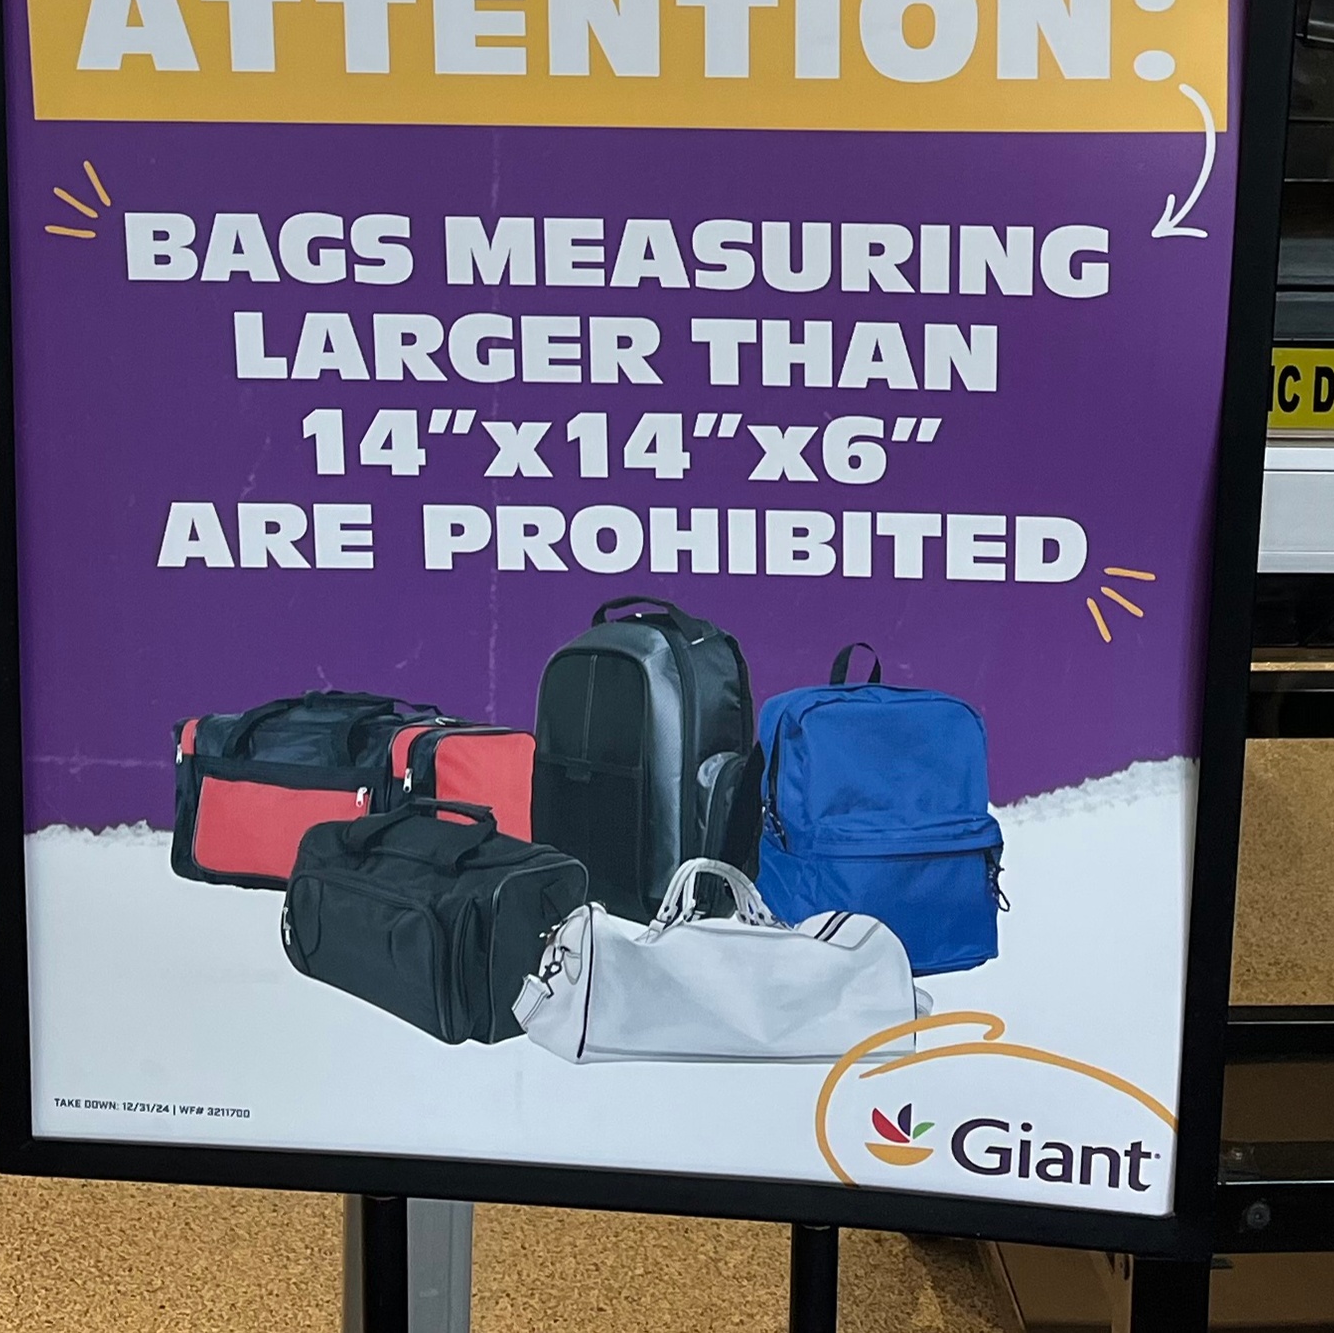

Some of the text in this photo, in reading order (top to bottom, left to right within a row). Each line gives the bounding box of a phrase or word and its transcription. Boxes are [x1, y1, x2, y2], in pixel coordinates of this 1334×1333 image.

[125, 213, 1109, 298] BAGS MEASURING
[234, 312, 997, 391] LARGER THAN
[157, 502, 1087, 582] ARE PROHIBITED
[54, 1098, 81, 1108] TAKE
[84, 1099, 119, 1111] DOWN:
[122, 1102, 170, 1113] 12/31/24
[179, 1106, 204, 1115] WF#
[207, 1107, 251, 1119] 3211700
[951, 1118, 1152, 1192] Giant
